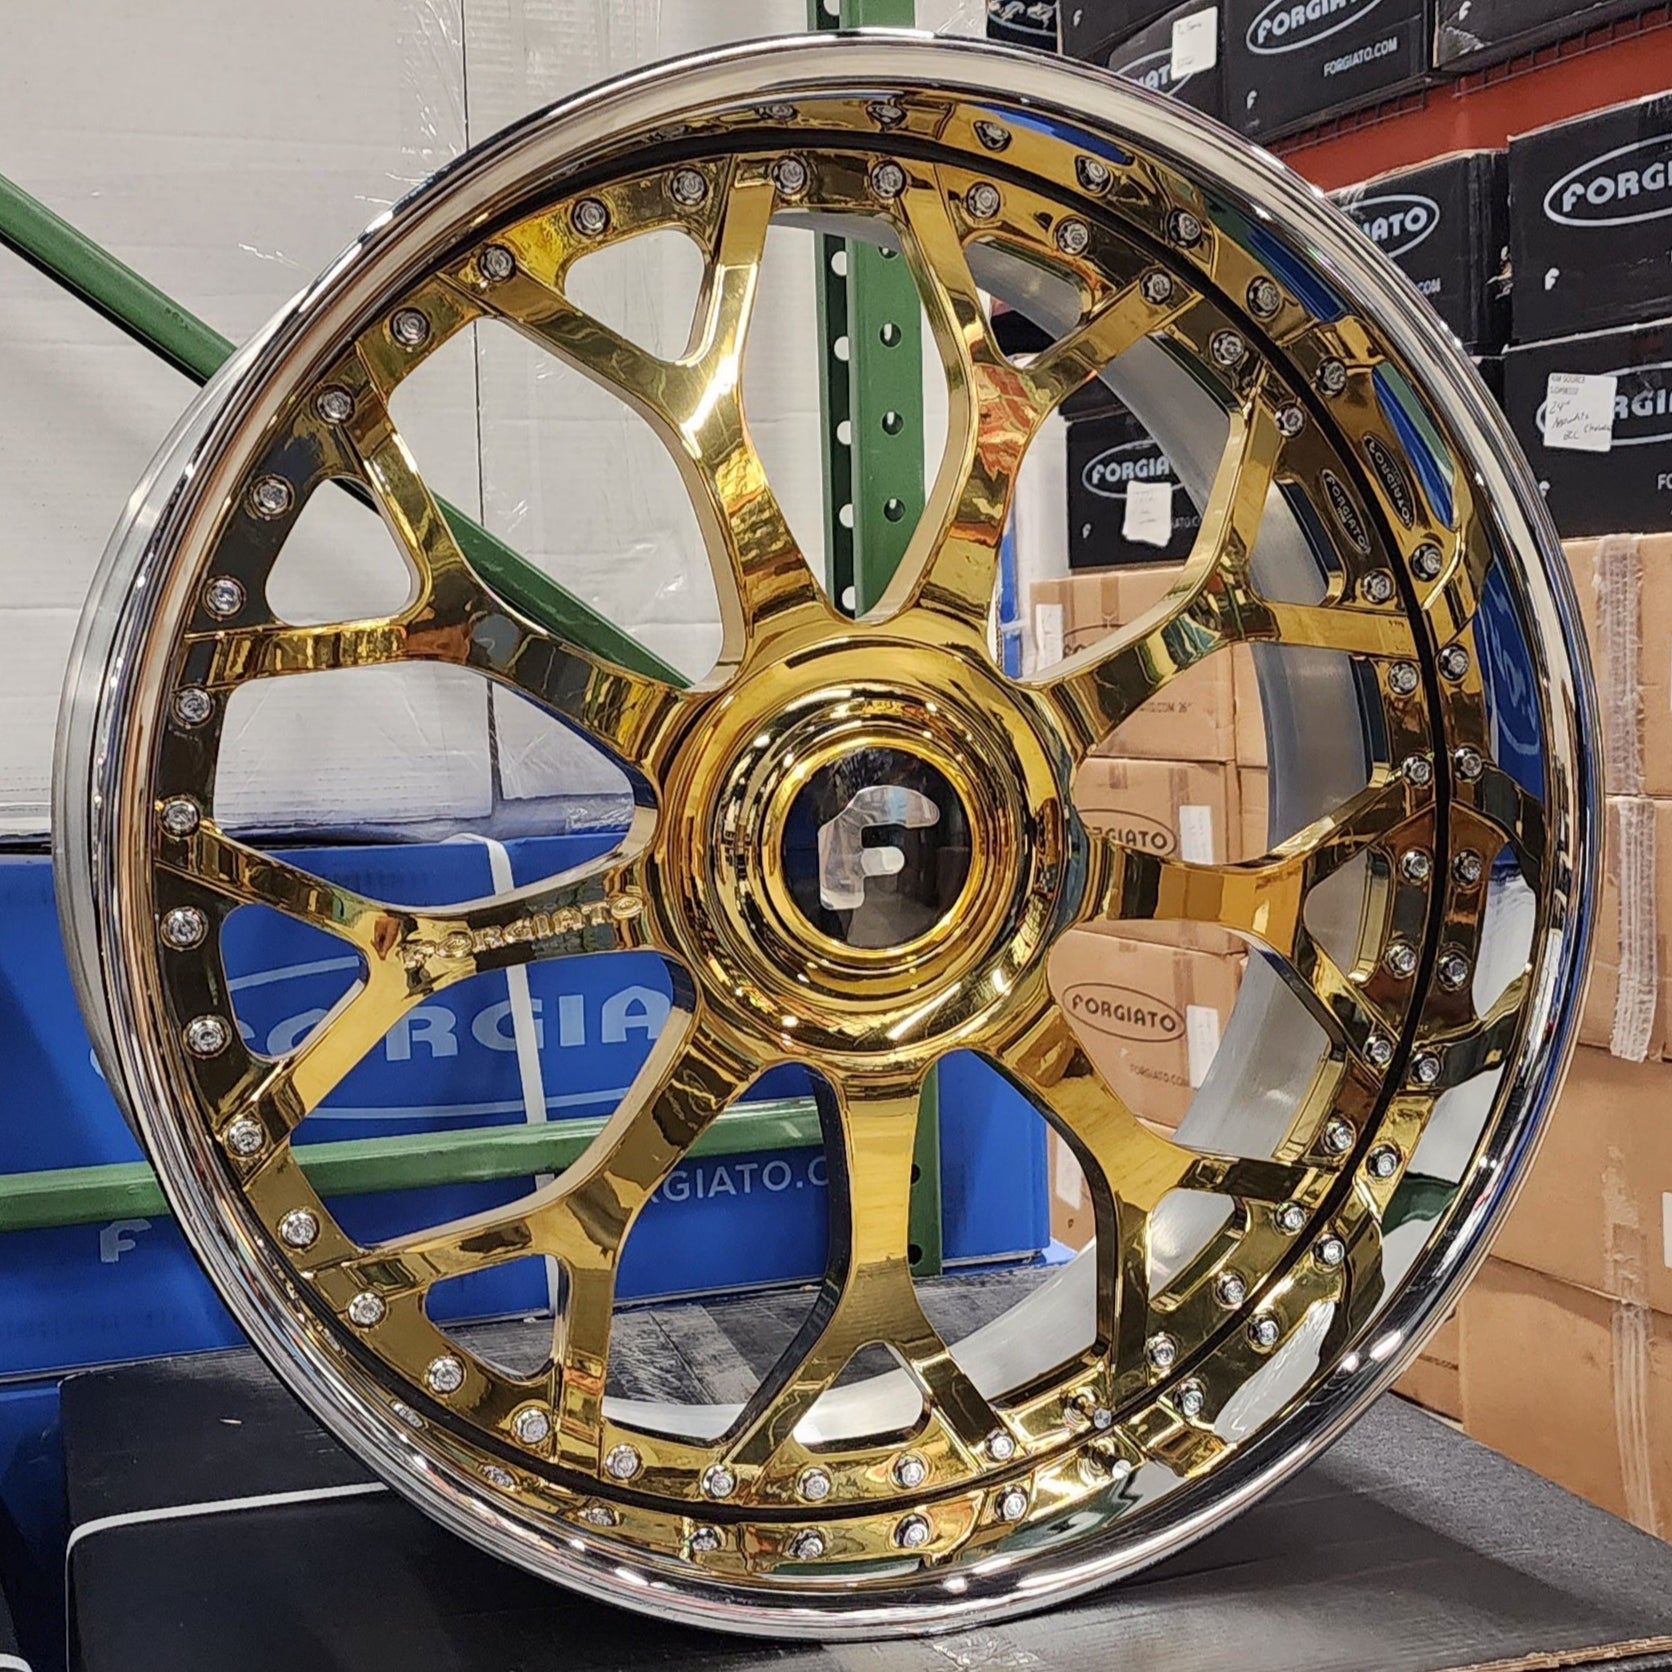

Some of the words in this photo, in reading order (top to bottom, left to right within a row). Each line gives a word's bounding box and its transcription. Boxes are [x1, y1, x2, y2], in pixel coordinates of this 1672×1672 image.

[1257, 0, 1357, 44] FORGIA
[1323, 37, 1398, 77] FORGIATO.COM
[1326, 475, 1367, 547] FORGIATO
[1072, 993, 1176, 1033] FORGIATO
[650, 1155, 830, 1204] GIATO.C
